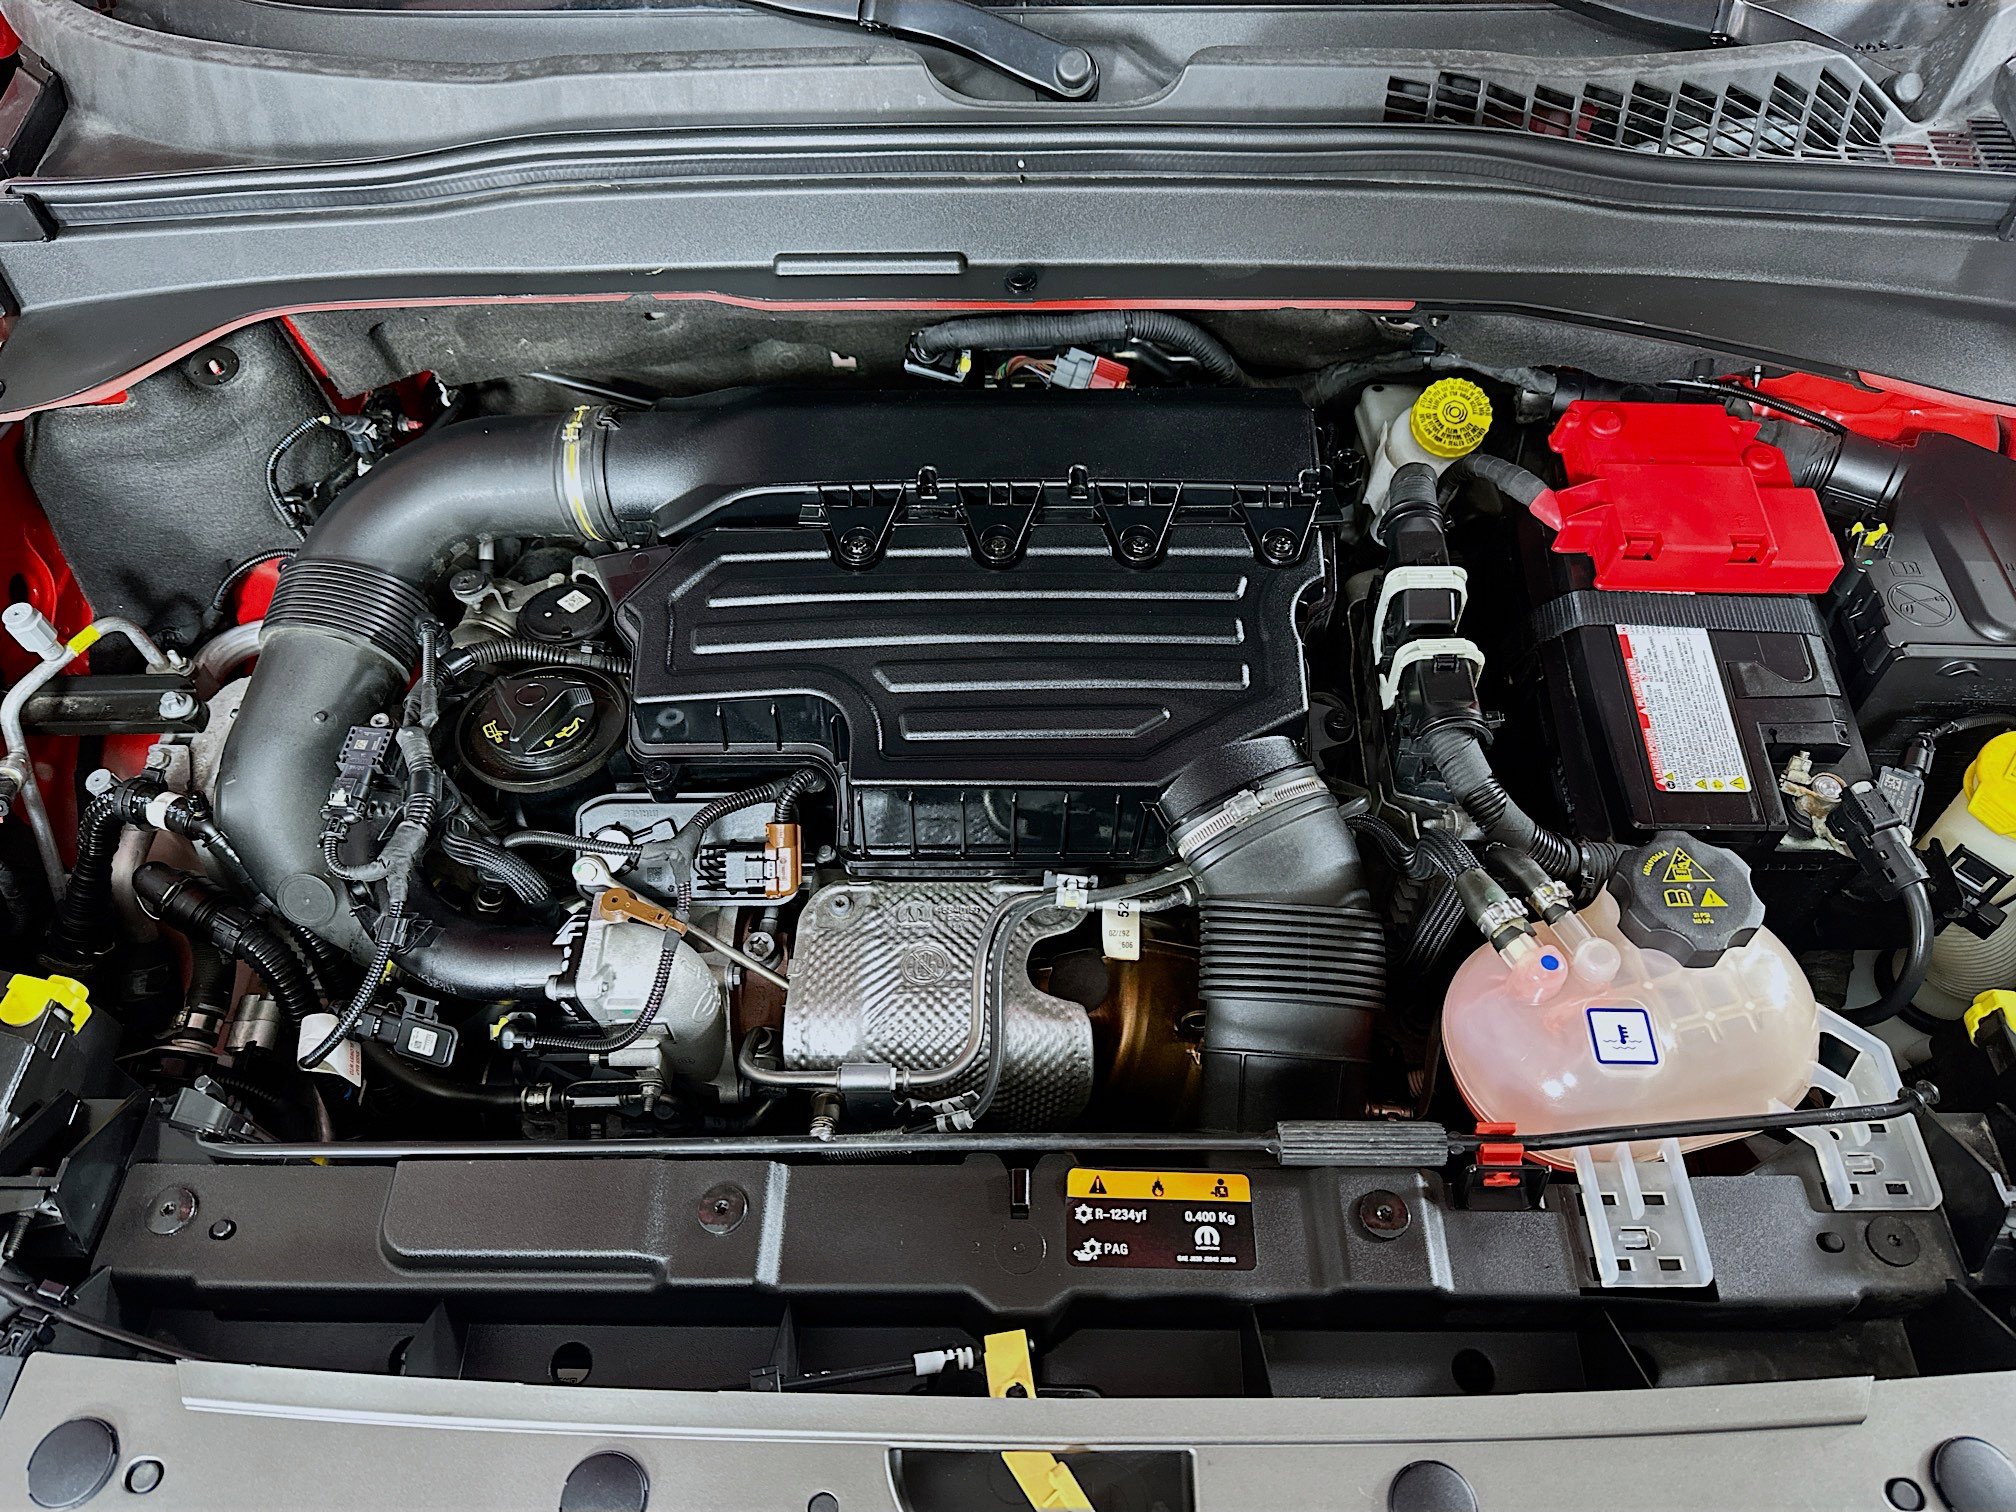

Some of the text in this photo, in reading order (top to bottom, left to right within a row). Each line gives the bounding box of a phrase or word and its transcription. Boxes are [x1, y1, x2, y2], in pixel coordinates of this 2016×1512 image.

[1626, 658, 1645, 706] PELIGRO/VENENO
[1643, 728, 1663, 777] DANGER/POISON
[1118, 899, 1129, 917] 52
[1095, 1209, 1147, 1223] R-1234yf
[1184, 1211, 1235, 1225] 0.400 Kg
[1104, 1243, 1129, 1255] PAG
